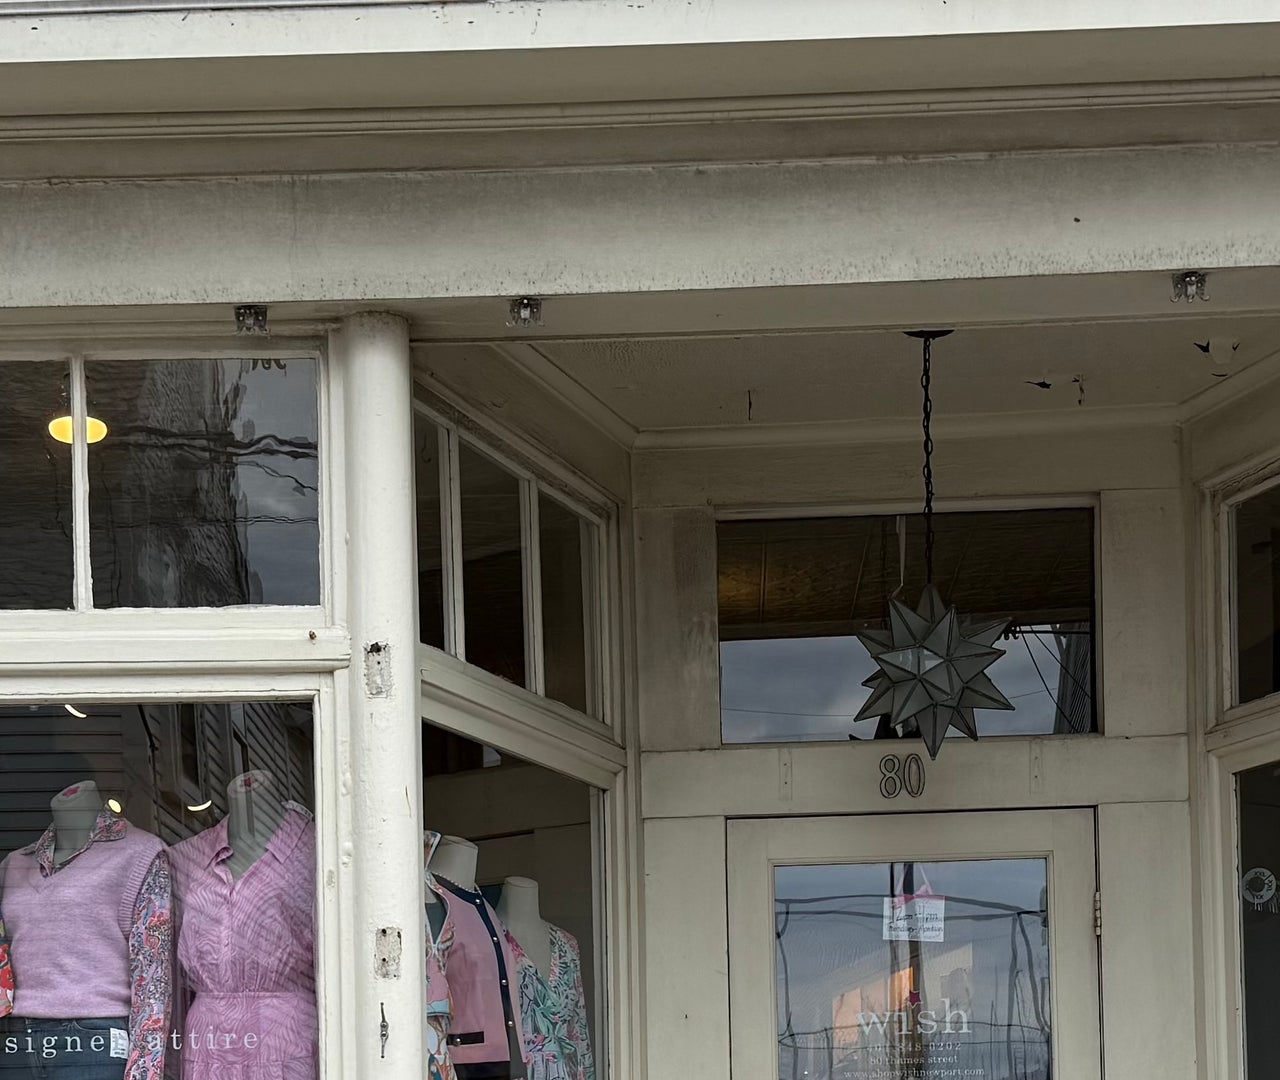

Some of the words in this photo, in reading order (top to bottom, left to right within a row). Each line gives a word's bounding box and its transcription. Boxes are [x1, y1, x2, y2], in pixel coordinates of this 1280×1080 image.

[879, 753, 926, 798] 80
[856, 998, 972, 1036] wish
[147, 1028, 259, 1051] attire
[927, 1055, 958, 1064] street
